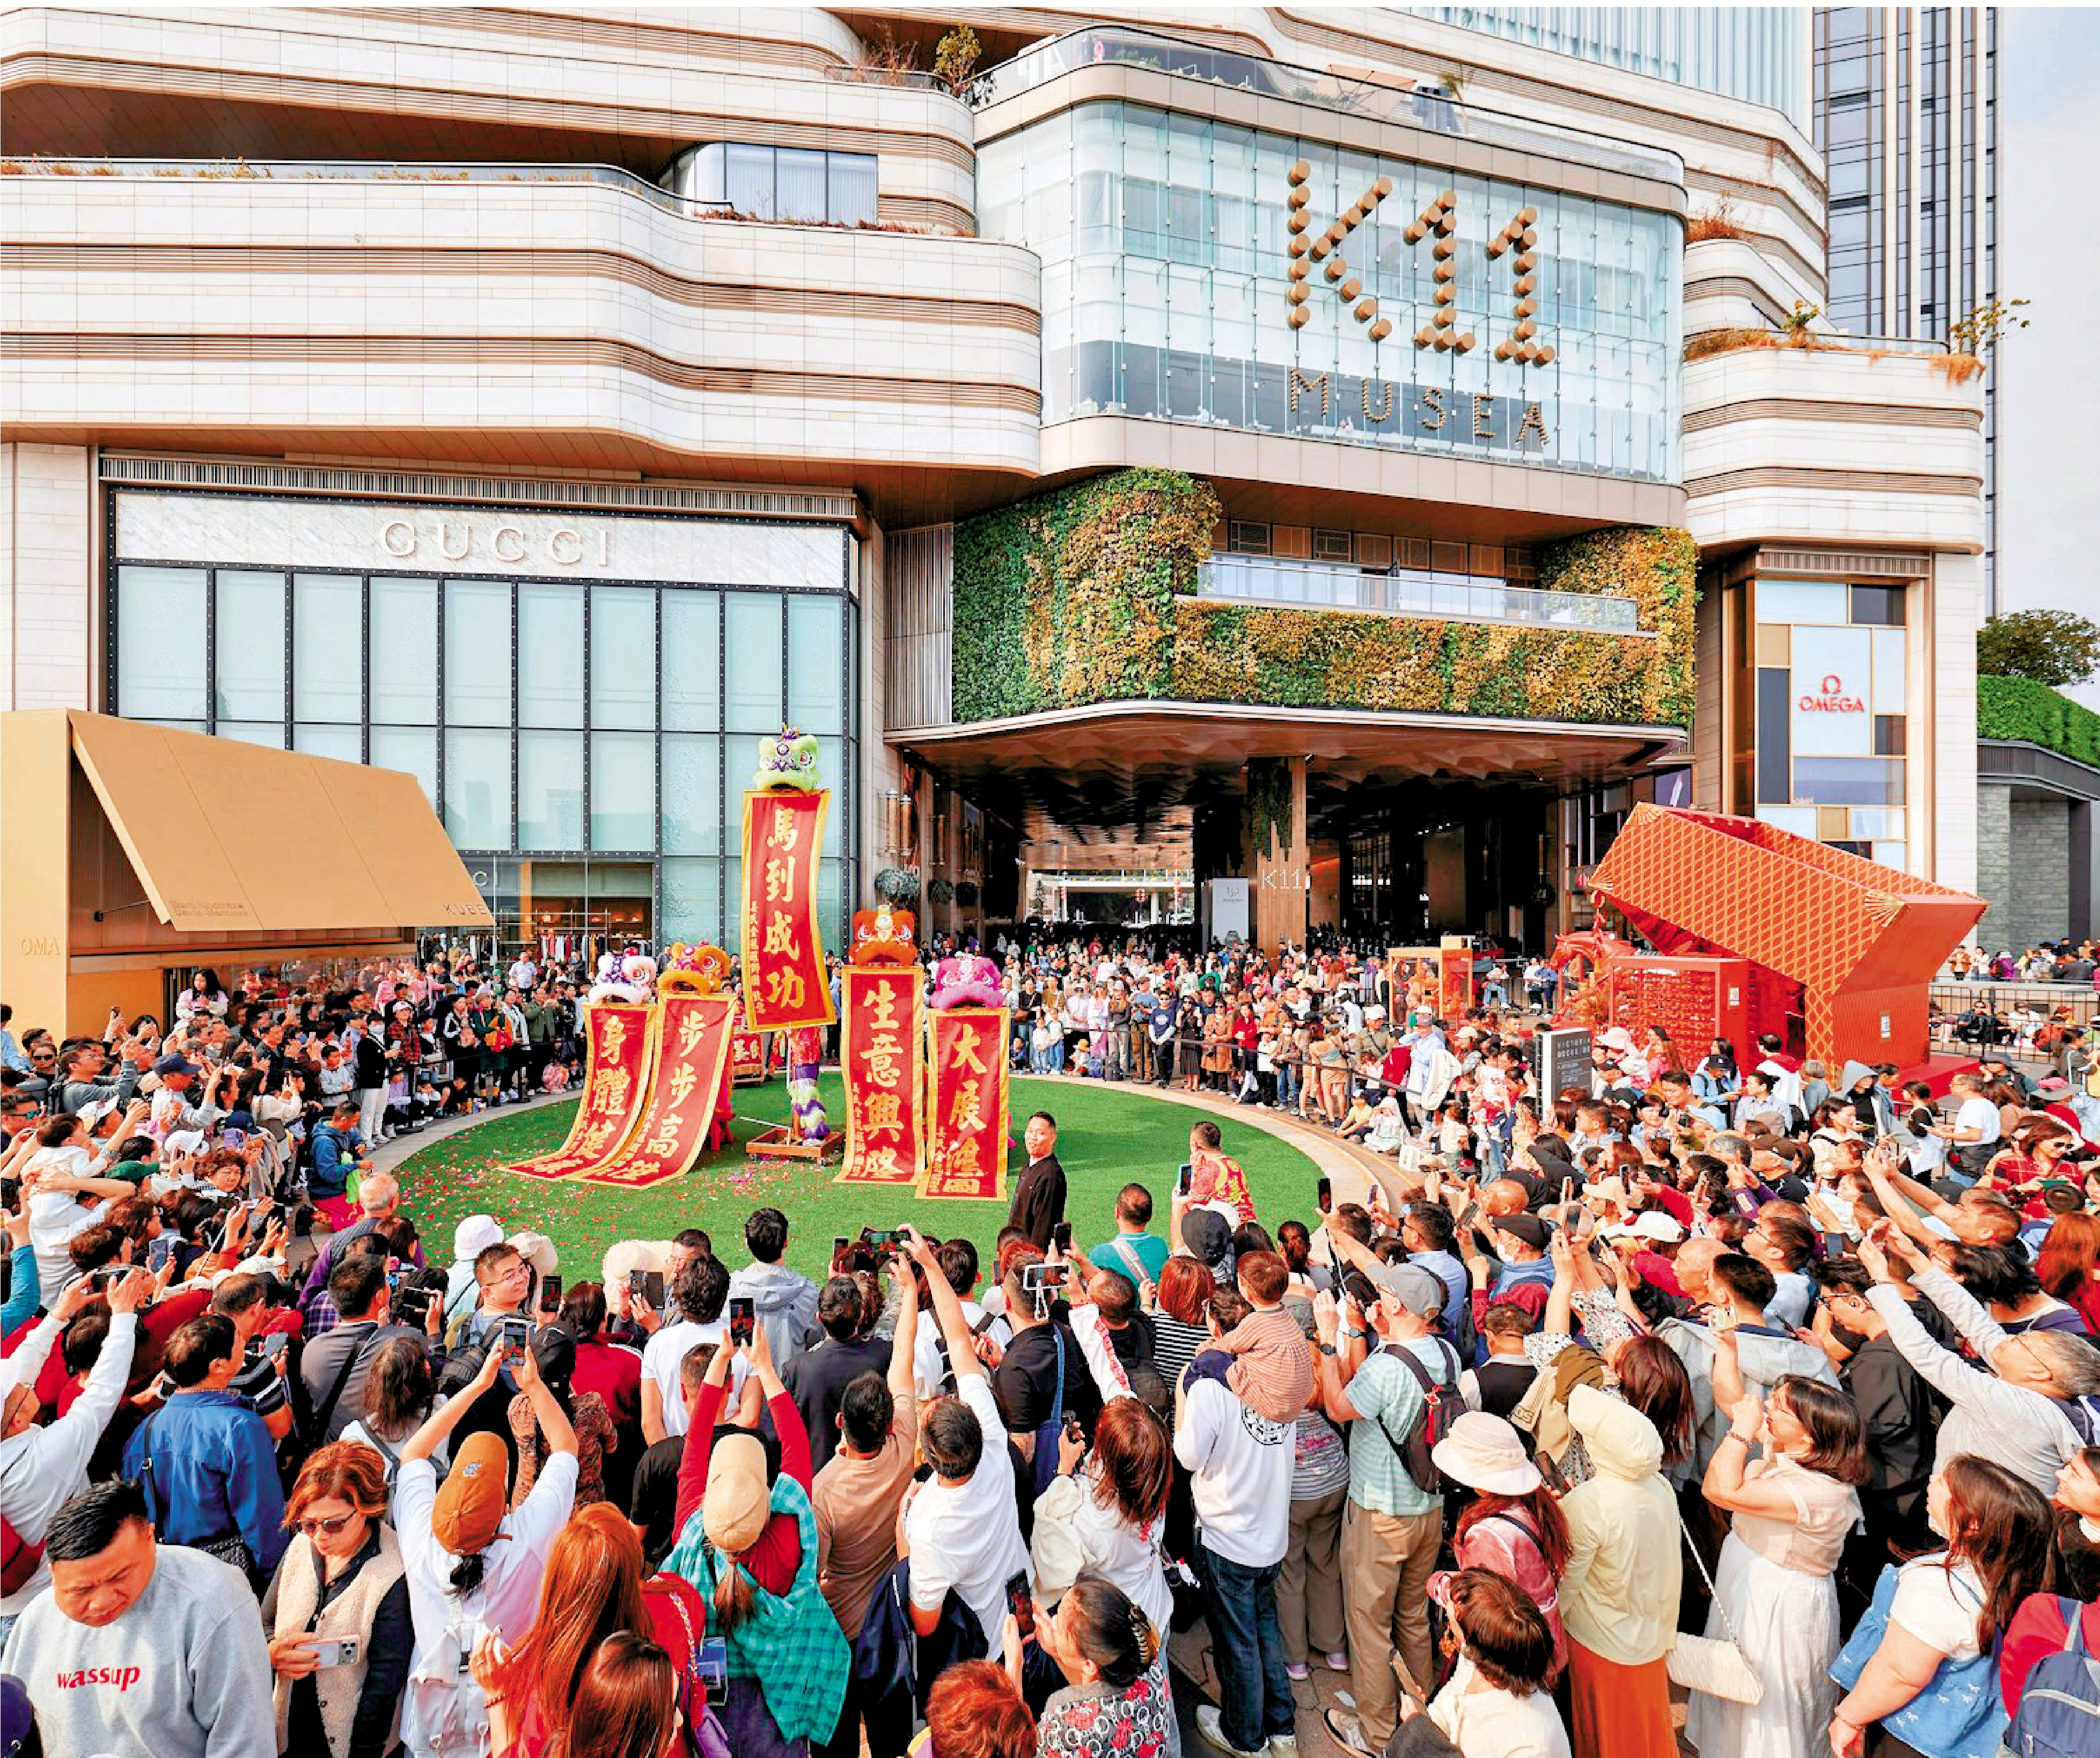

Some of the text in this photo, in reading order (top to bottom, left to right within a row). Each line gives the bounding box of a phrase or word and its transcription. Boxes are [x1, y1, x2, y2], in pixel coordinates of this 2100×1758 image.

[1288, 158, 1555, 368] K11
[1290, 367, 1550, 445] MUSEA
[380, 520, 608, 568] GUCCI
[1798, 695, 1866, 713] OMEGA
[763, 809, 804, 1009] 馬到成功
[1262, 869, 1303, 890] K11
[20, 937, 61, 956] OMA
[860, 980, 906, 1179] 生意興隆
[942, 1023, 987, 1194] 大展鴻圖
[57, 1666, 141, 1693] wassup
